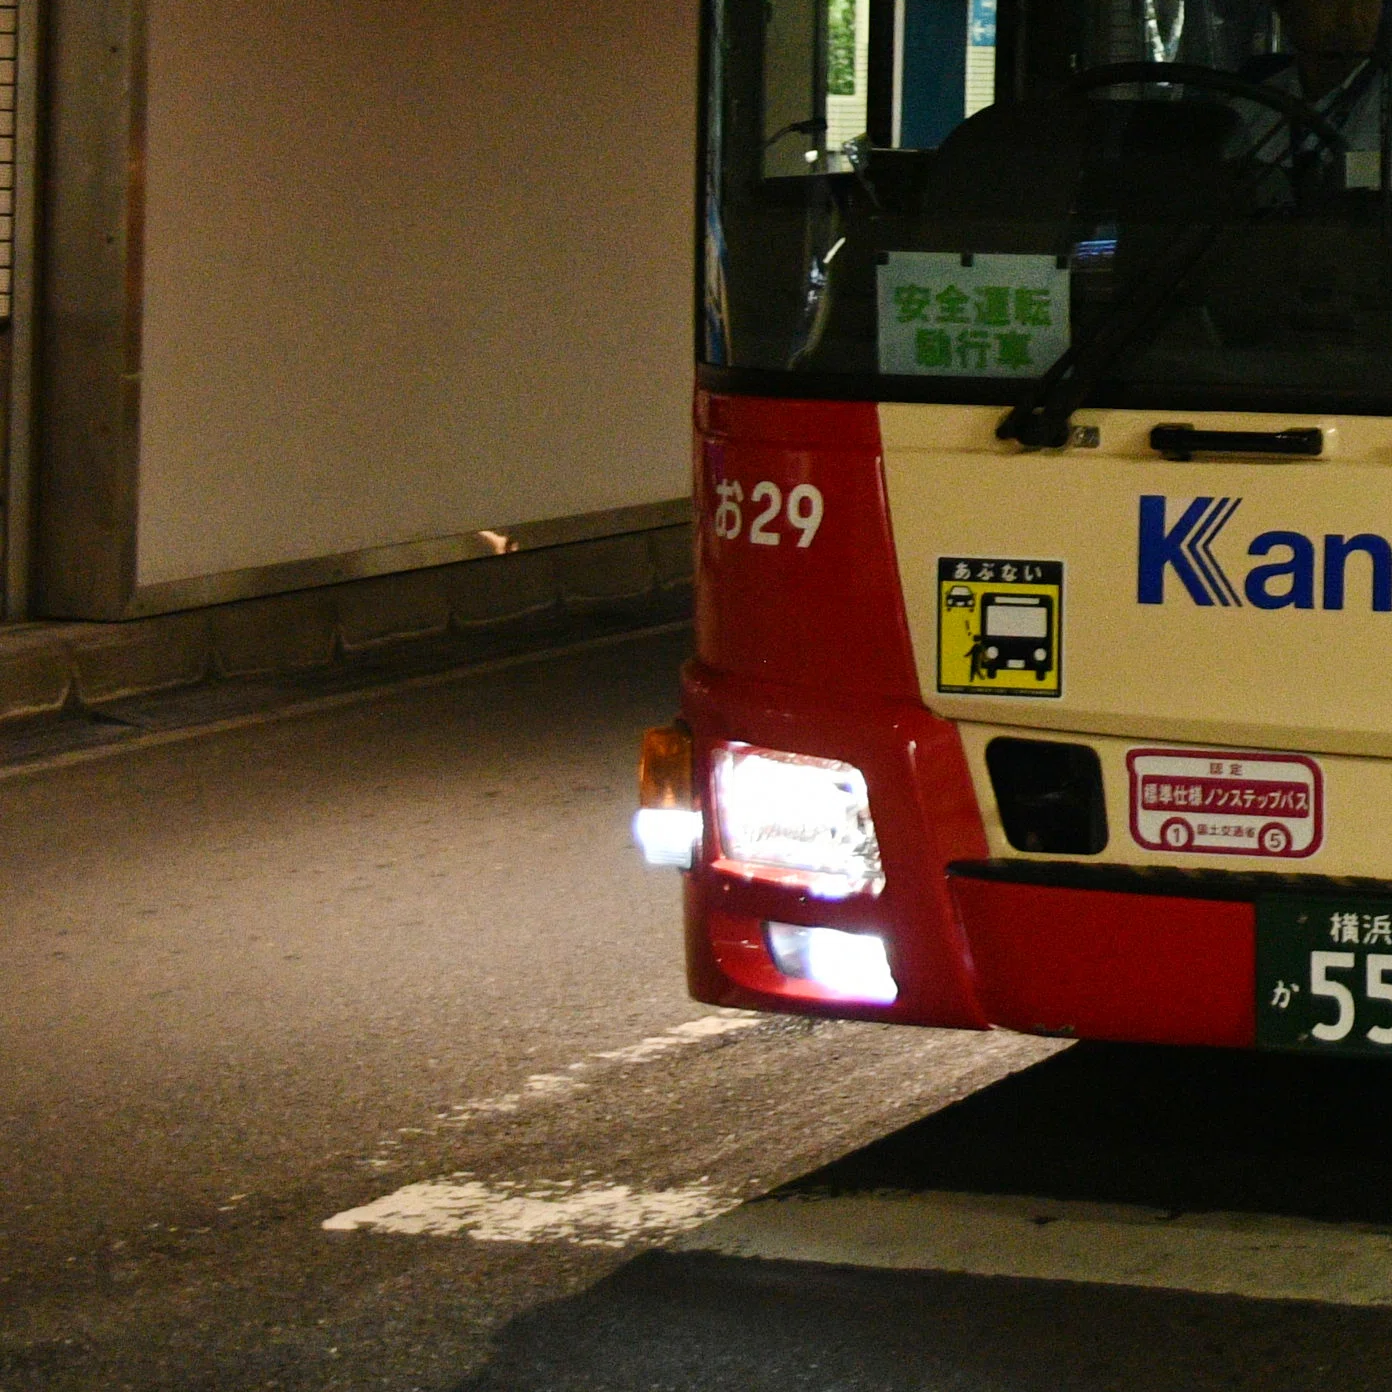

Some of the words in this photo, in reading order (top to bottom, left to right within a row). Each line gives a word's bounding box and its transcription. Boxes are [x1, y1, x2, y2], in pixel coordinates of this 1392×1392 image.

[953, 561, 1043, 583] あぶない
[1271, 979, 1300, 1009] か
